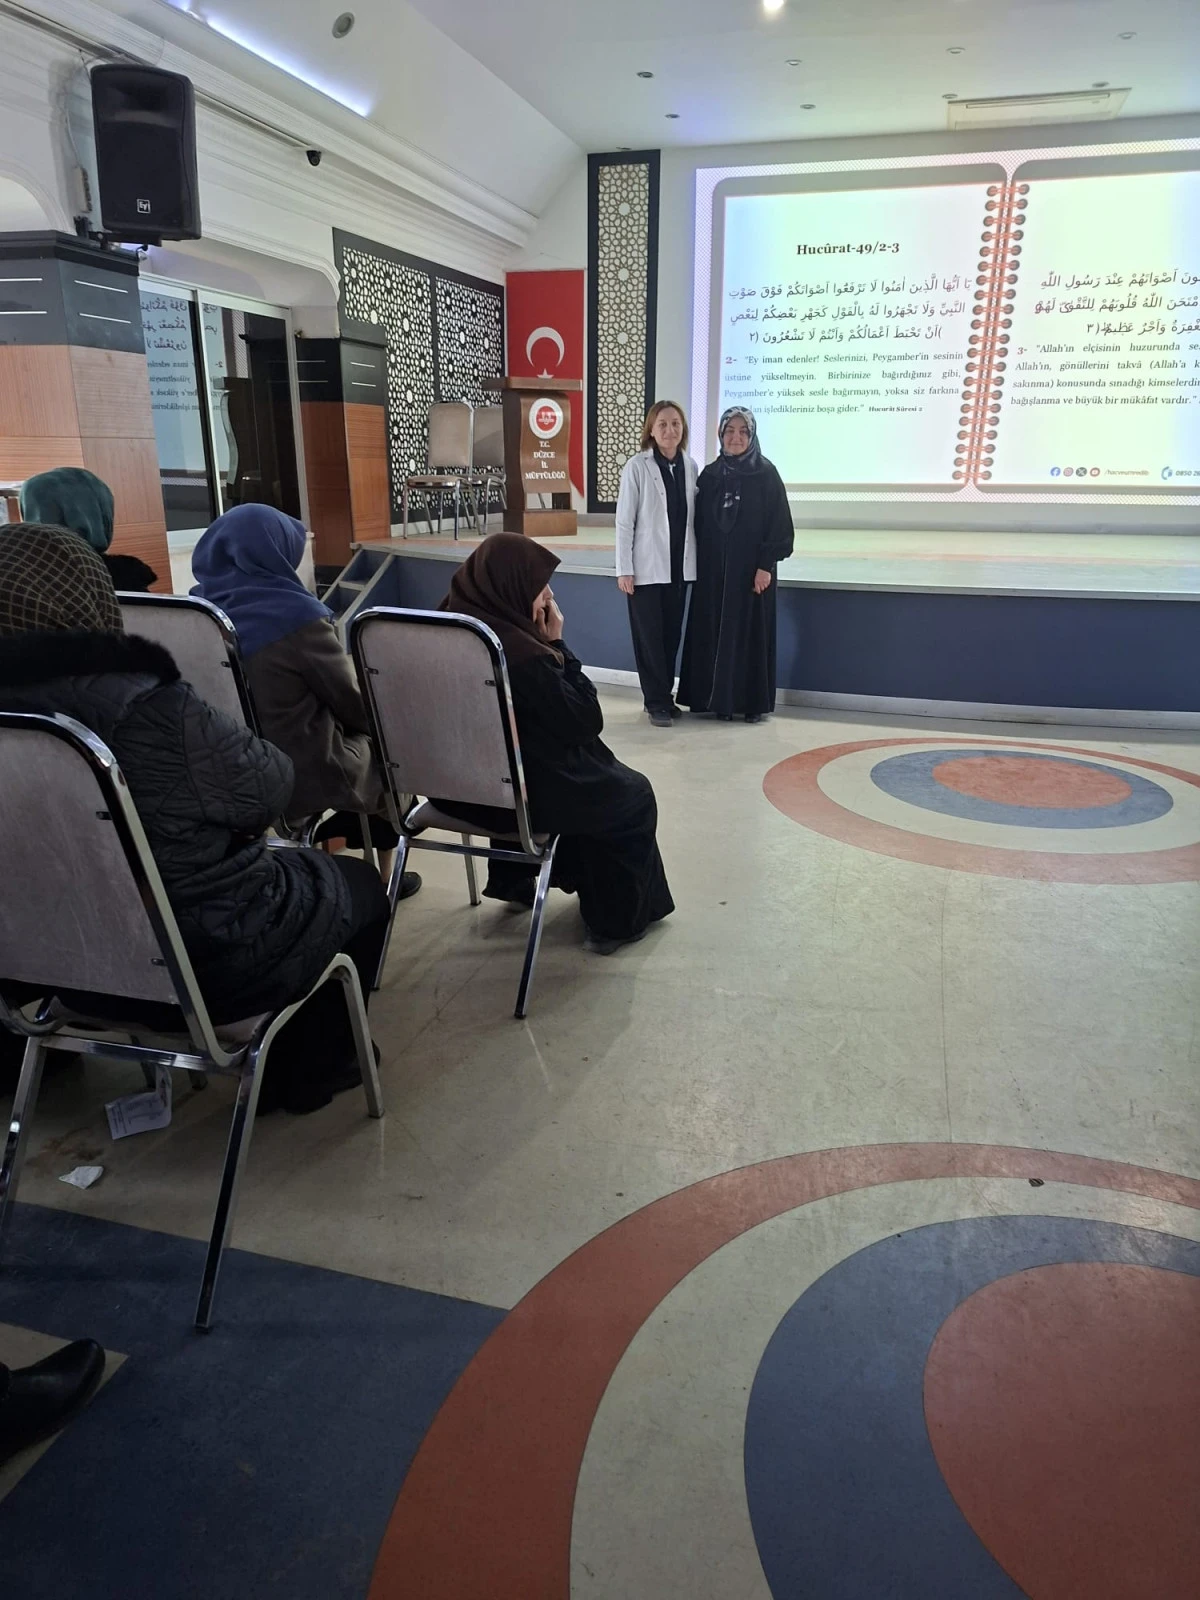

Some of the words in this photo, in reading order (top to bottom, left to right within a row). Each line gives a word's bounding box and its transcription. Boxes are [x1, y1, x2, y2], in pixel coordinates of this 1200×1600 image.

[797, 241, 900, 256] Hucûrat-49/2-3
[1017, 347, 1028, 355] 3-
[1082, 344, 1121, 353] elçisinin
[1130, 342, 1180, 352] huzurunda
[725, 356, 737, 364] 2-
[762, 355, 783, 364] iman
[786, 354, 820, 364] edenler!
[823, 354, 868, 364] Seslerinizi,
[933, 351, 964, 361] sesinin
[1060, 361, 1110, 372] gönüllerini
[1117, 360, 1142, 370] takvâ
[724, 372, 752, 381] üstüne
[761, 371, 816, 383] yükseltmeyin.
[828, 371, 872, 380] Birbirinize
[882, 370, 932, 381] bağırdığınız
[942, 369, 961, 381] gibi,
[1012, 378, 1055, 389] sakınma)
[1056, 378, 1107, 388] konusunda
[1109, 378, 1145, 389] sınadığı
[777, 387, 805, 399] yüksek
[809, 387, 829, 396] sesle
[832, 387, 881, 398] bağırmayın,
[885, 386, 909, 397] yoksa
[913, 386, 925, 395] siz
[929, 386, 959, 396] farkına
[1011, 396, 1061, 406] bağışlanma
[1063, 397, 1073, 405] ve
[1075, 396, 1103, 407] büyük
[1105, 396, 1118, 405] bir
[1120, 395, 1158, 405] mükâfat
[764, 404, 815, 415] işledikleriniz
[817, 404, 836, 415] boşa
[533, 450, 556, 459] DÜZCE
